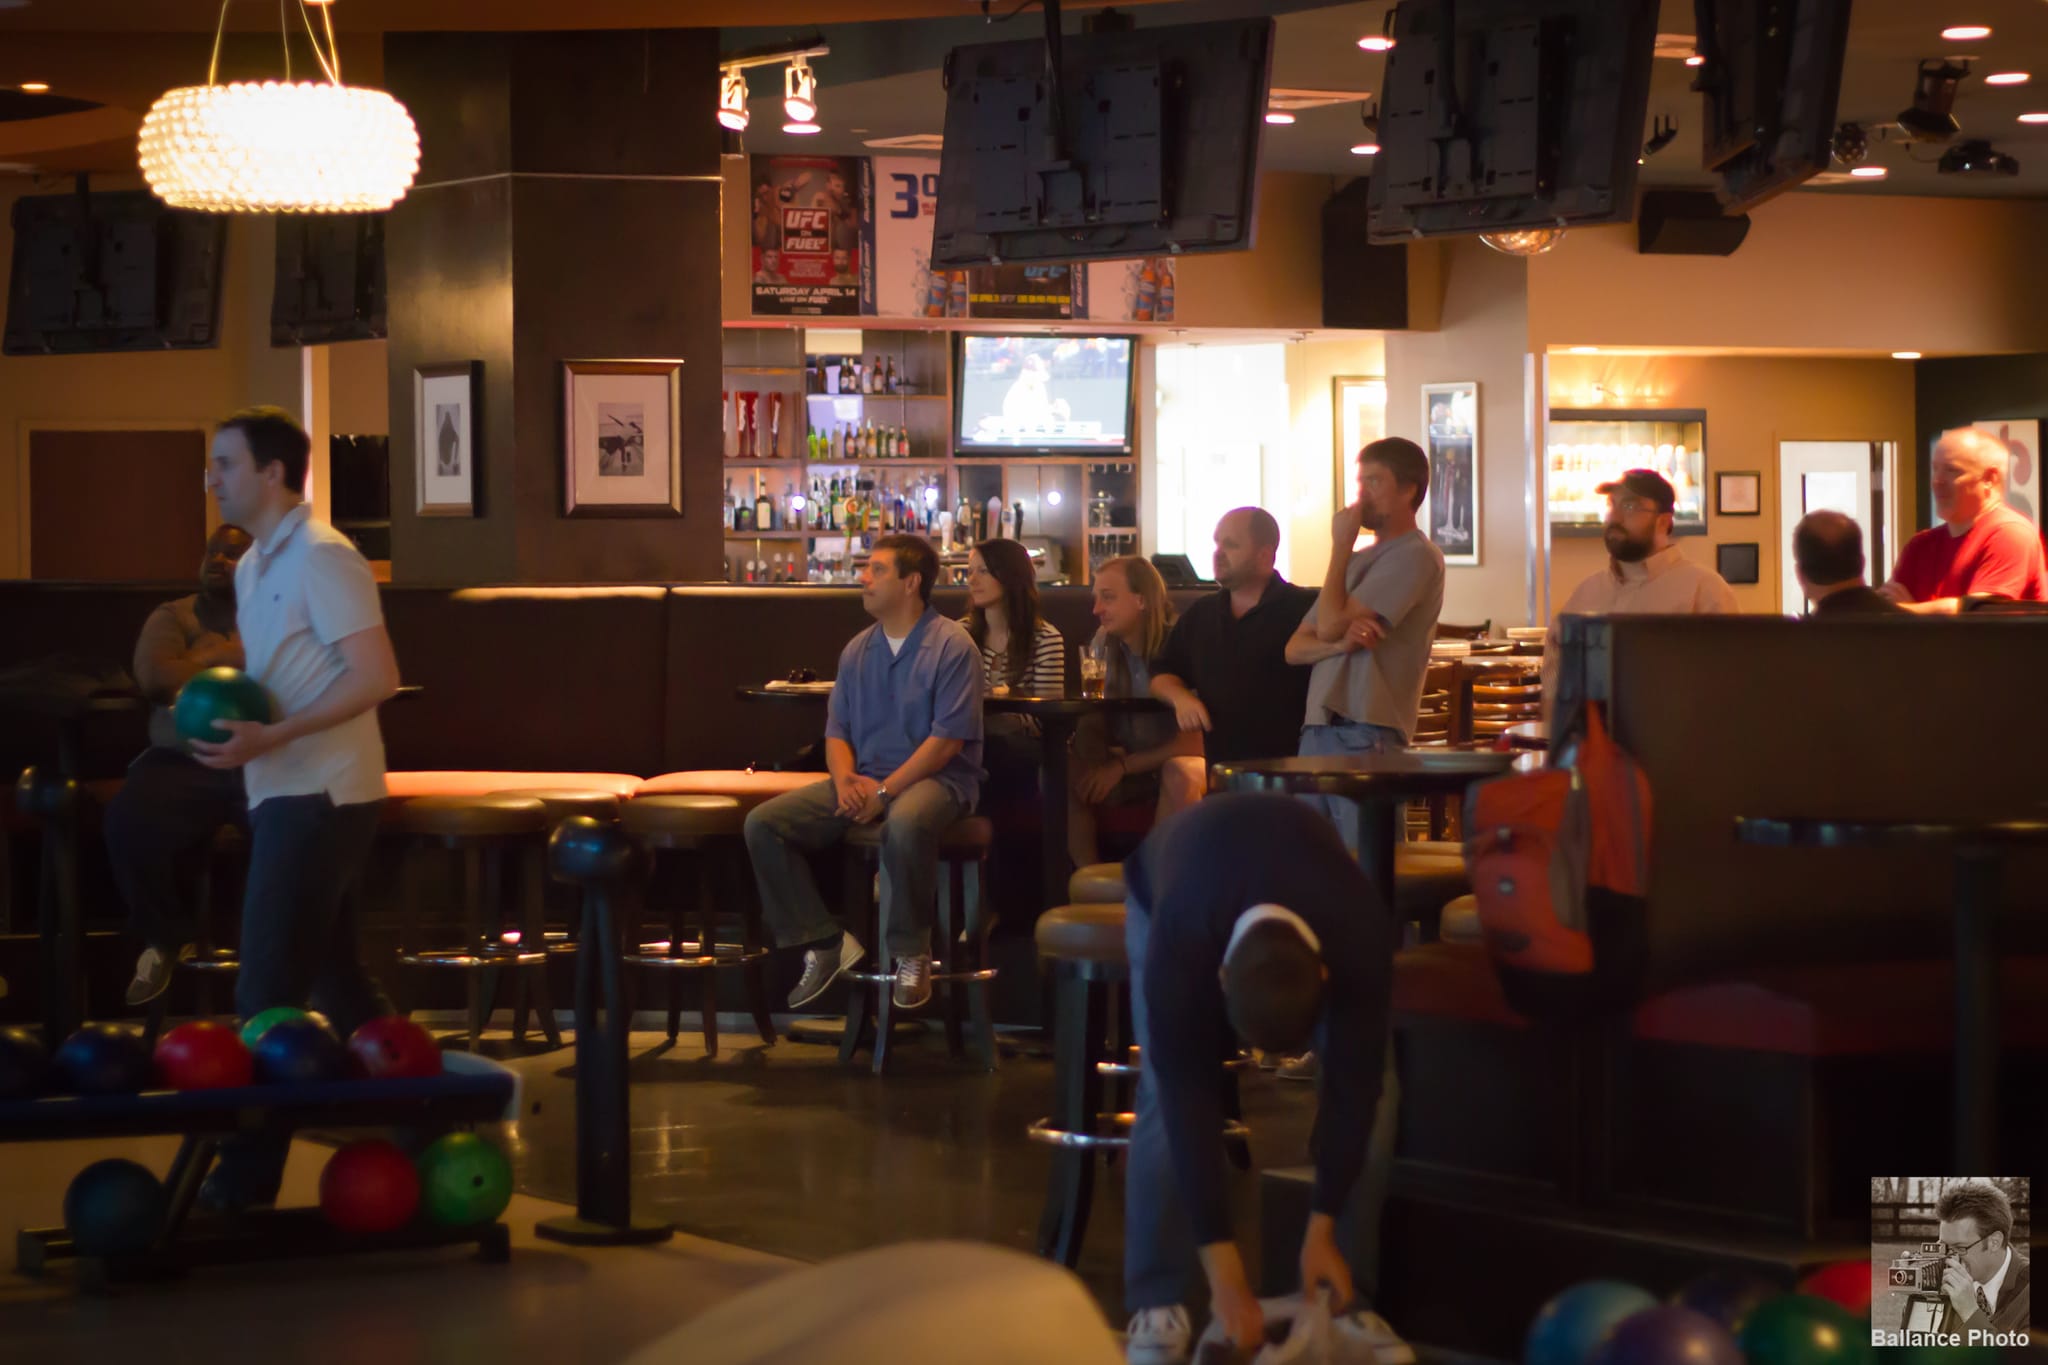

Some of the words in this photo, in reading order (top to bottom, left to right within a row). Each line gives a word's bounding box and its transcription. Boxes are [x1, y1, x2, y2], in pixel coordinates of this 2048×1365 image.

[786, 210, 827, 229] UFC
[786, 238, 822, 250] FUEL
[755, 286, 810, 295] SATURDAY
[814, 287, 843, 296] APRIL
[845, 288, 856, 296] 14
